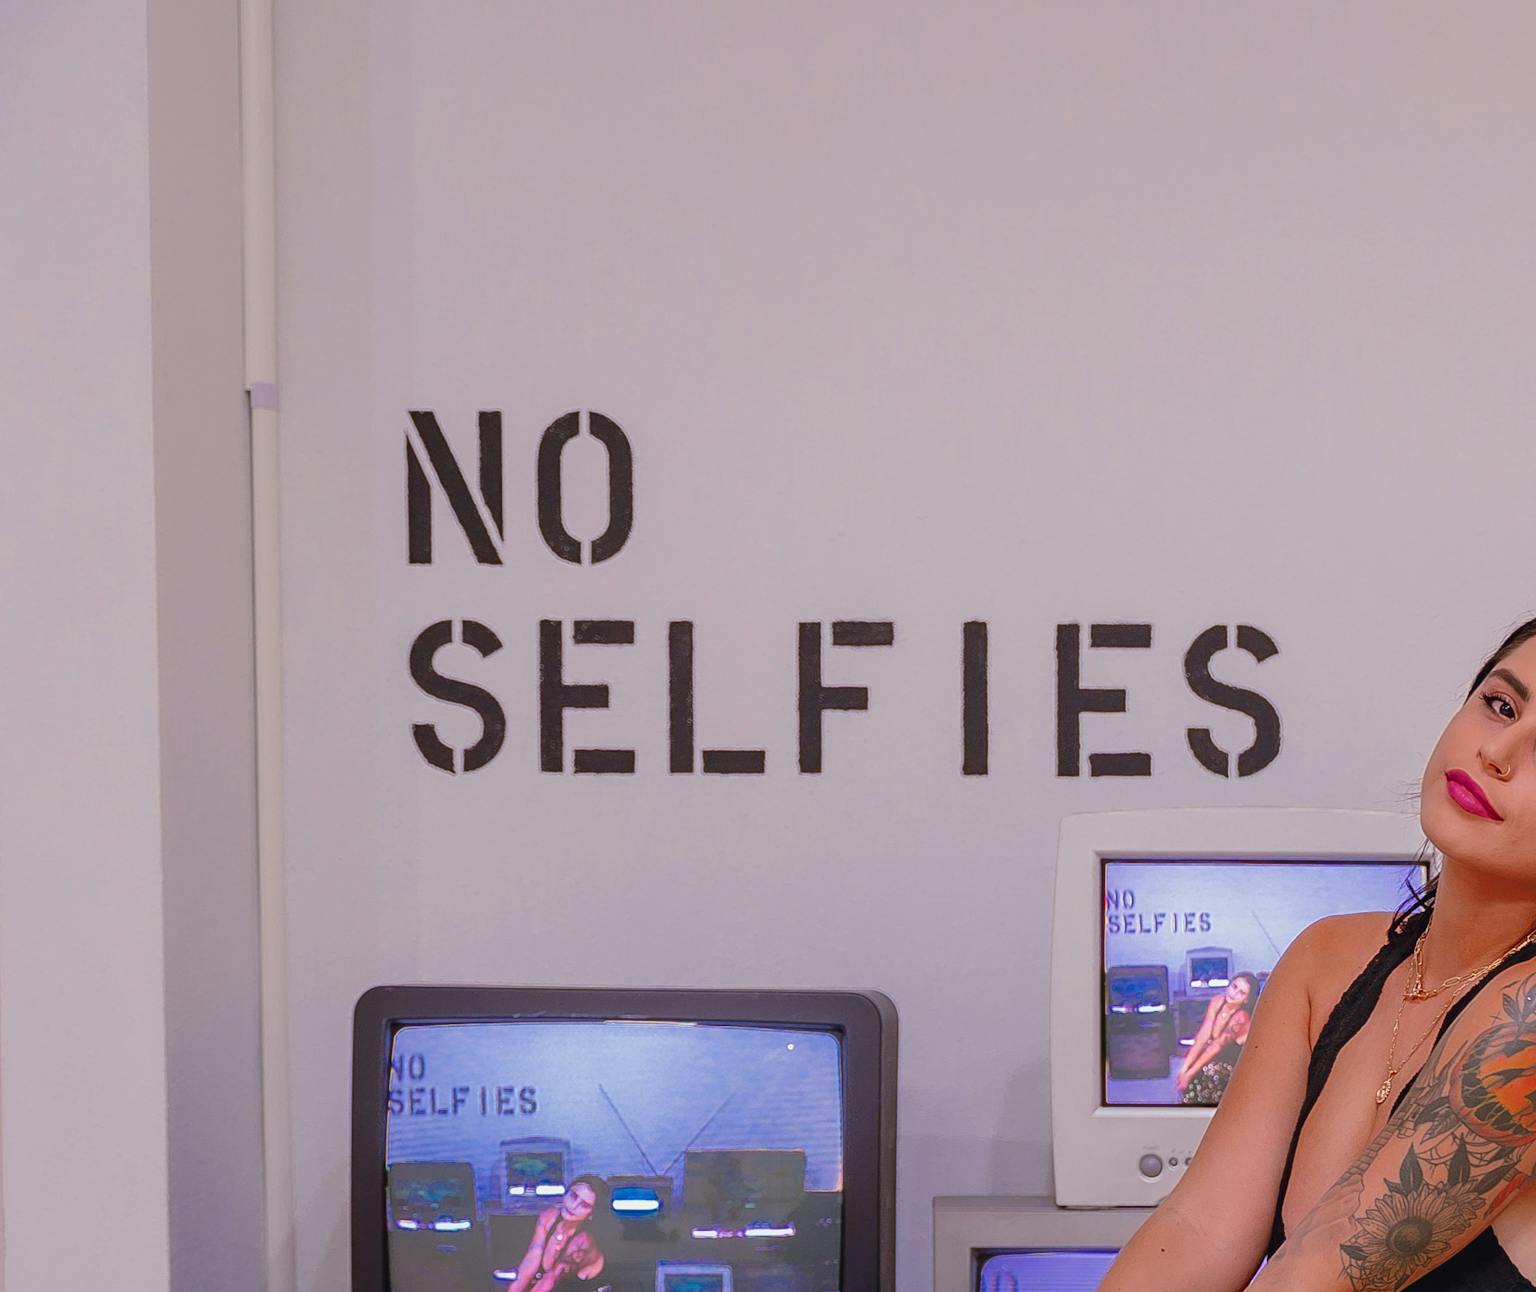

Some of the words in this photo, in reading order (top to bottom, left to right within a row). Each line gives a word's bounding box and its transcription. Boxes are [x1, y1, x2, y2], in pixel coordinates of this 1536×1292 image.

[406, 410, 634, 566] NO
[408, 618, 1282, 778] SELFIES
[1106, 889, 1135, 910] NO
[1108, 912, 1211, 934] SELFIES
[389, 1085, 538, 1117] SELFIES
